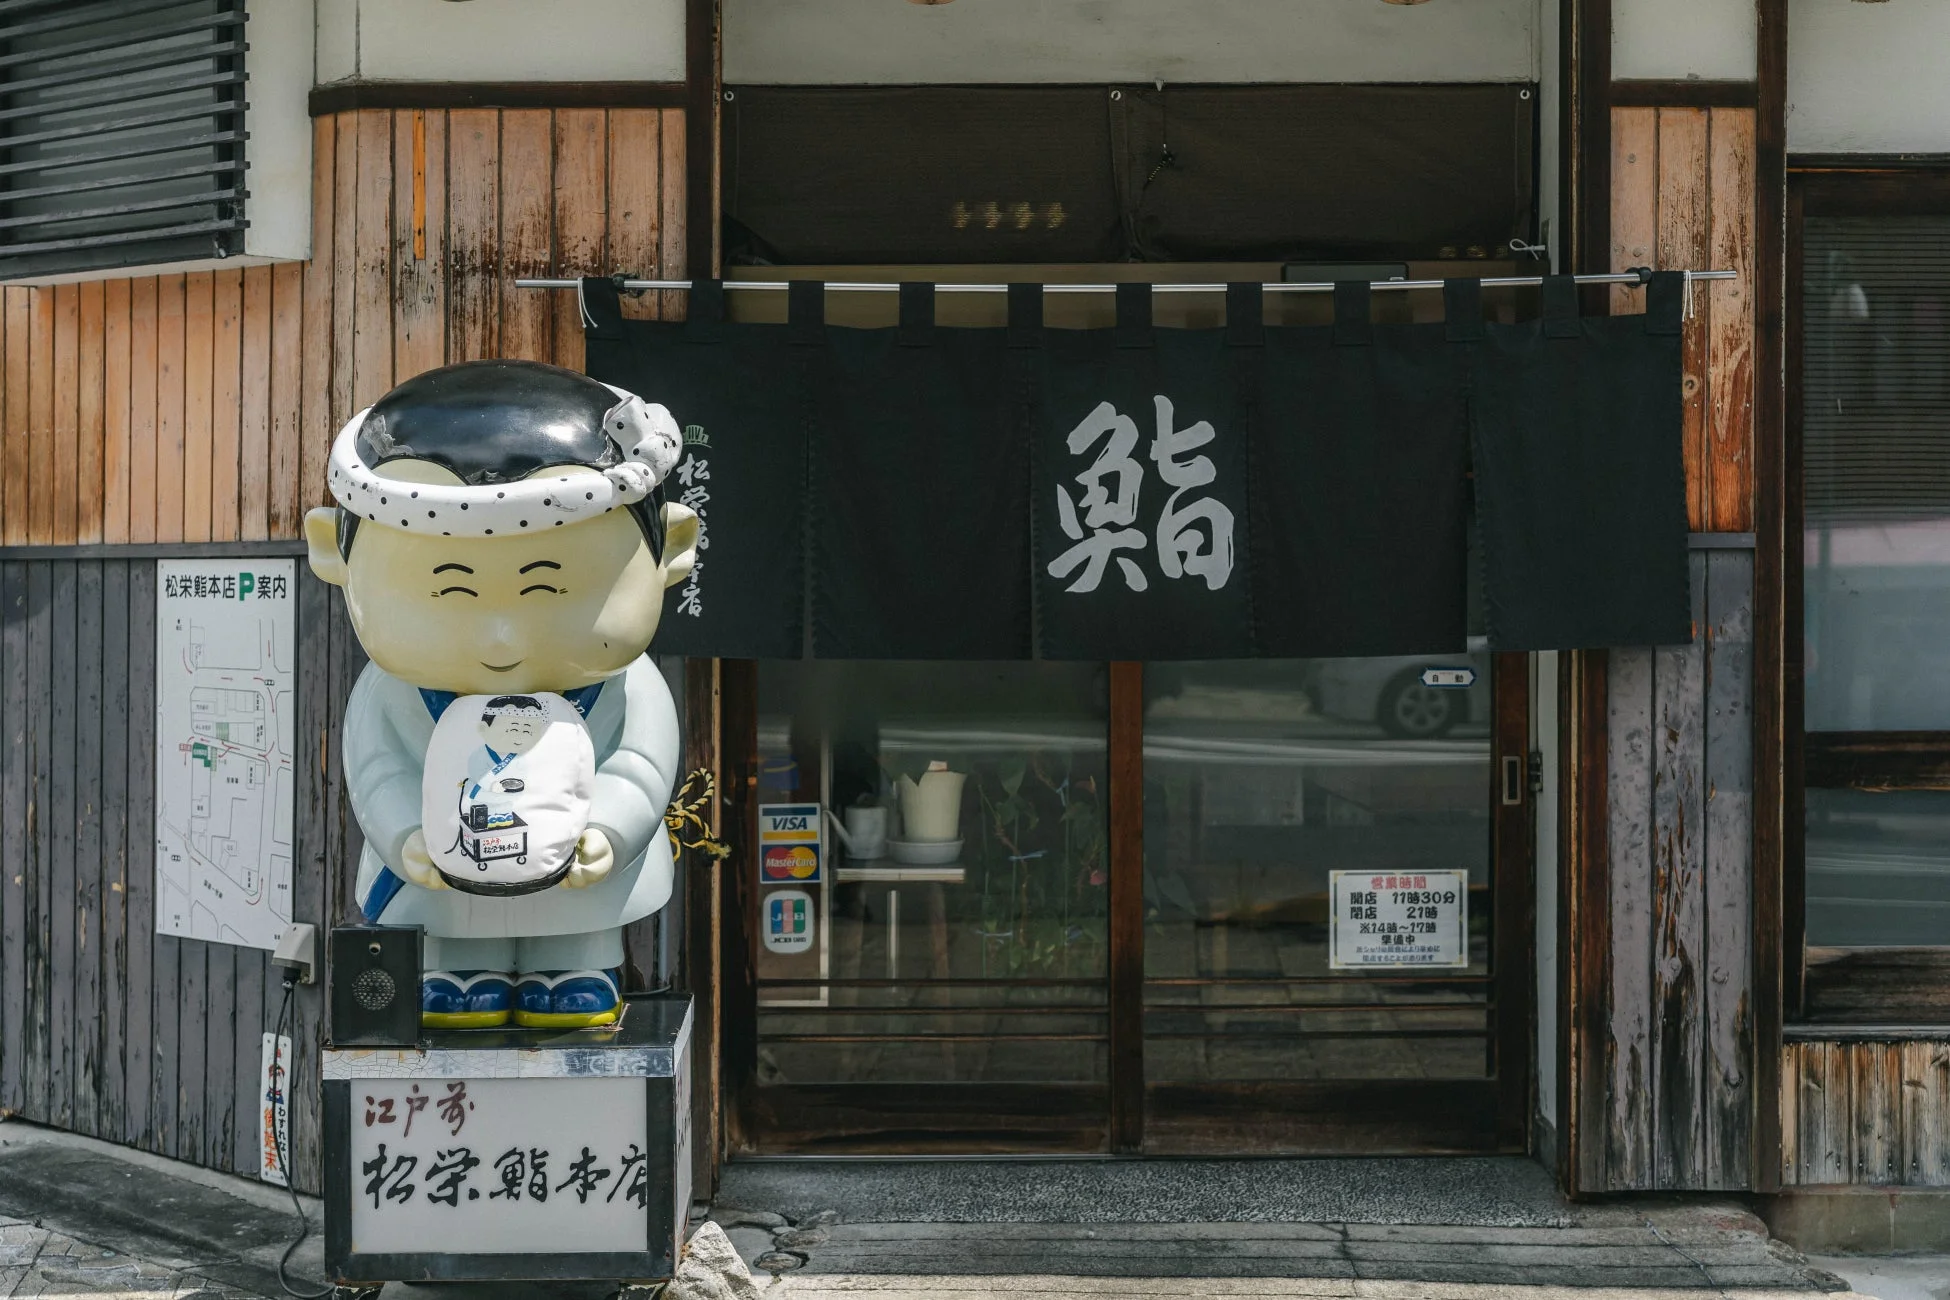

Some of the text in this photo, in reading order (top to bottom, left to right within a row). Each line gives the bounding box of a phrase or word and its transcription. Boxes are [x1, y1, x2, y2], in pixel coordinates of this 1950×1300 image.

[1047, 395, 1235, 593] 鮨
[772, 817, 808, 831] VISA
[766, 857, 816, 868] MasterCard
[1371, 876, 1427, 890] 営業時間
[1350, 891, 1456, 905] 開店 11時30分
[1350, 906, 1438, 920] 閉店 21時
[1381, 934, 1416, 945] 準備中
